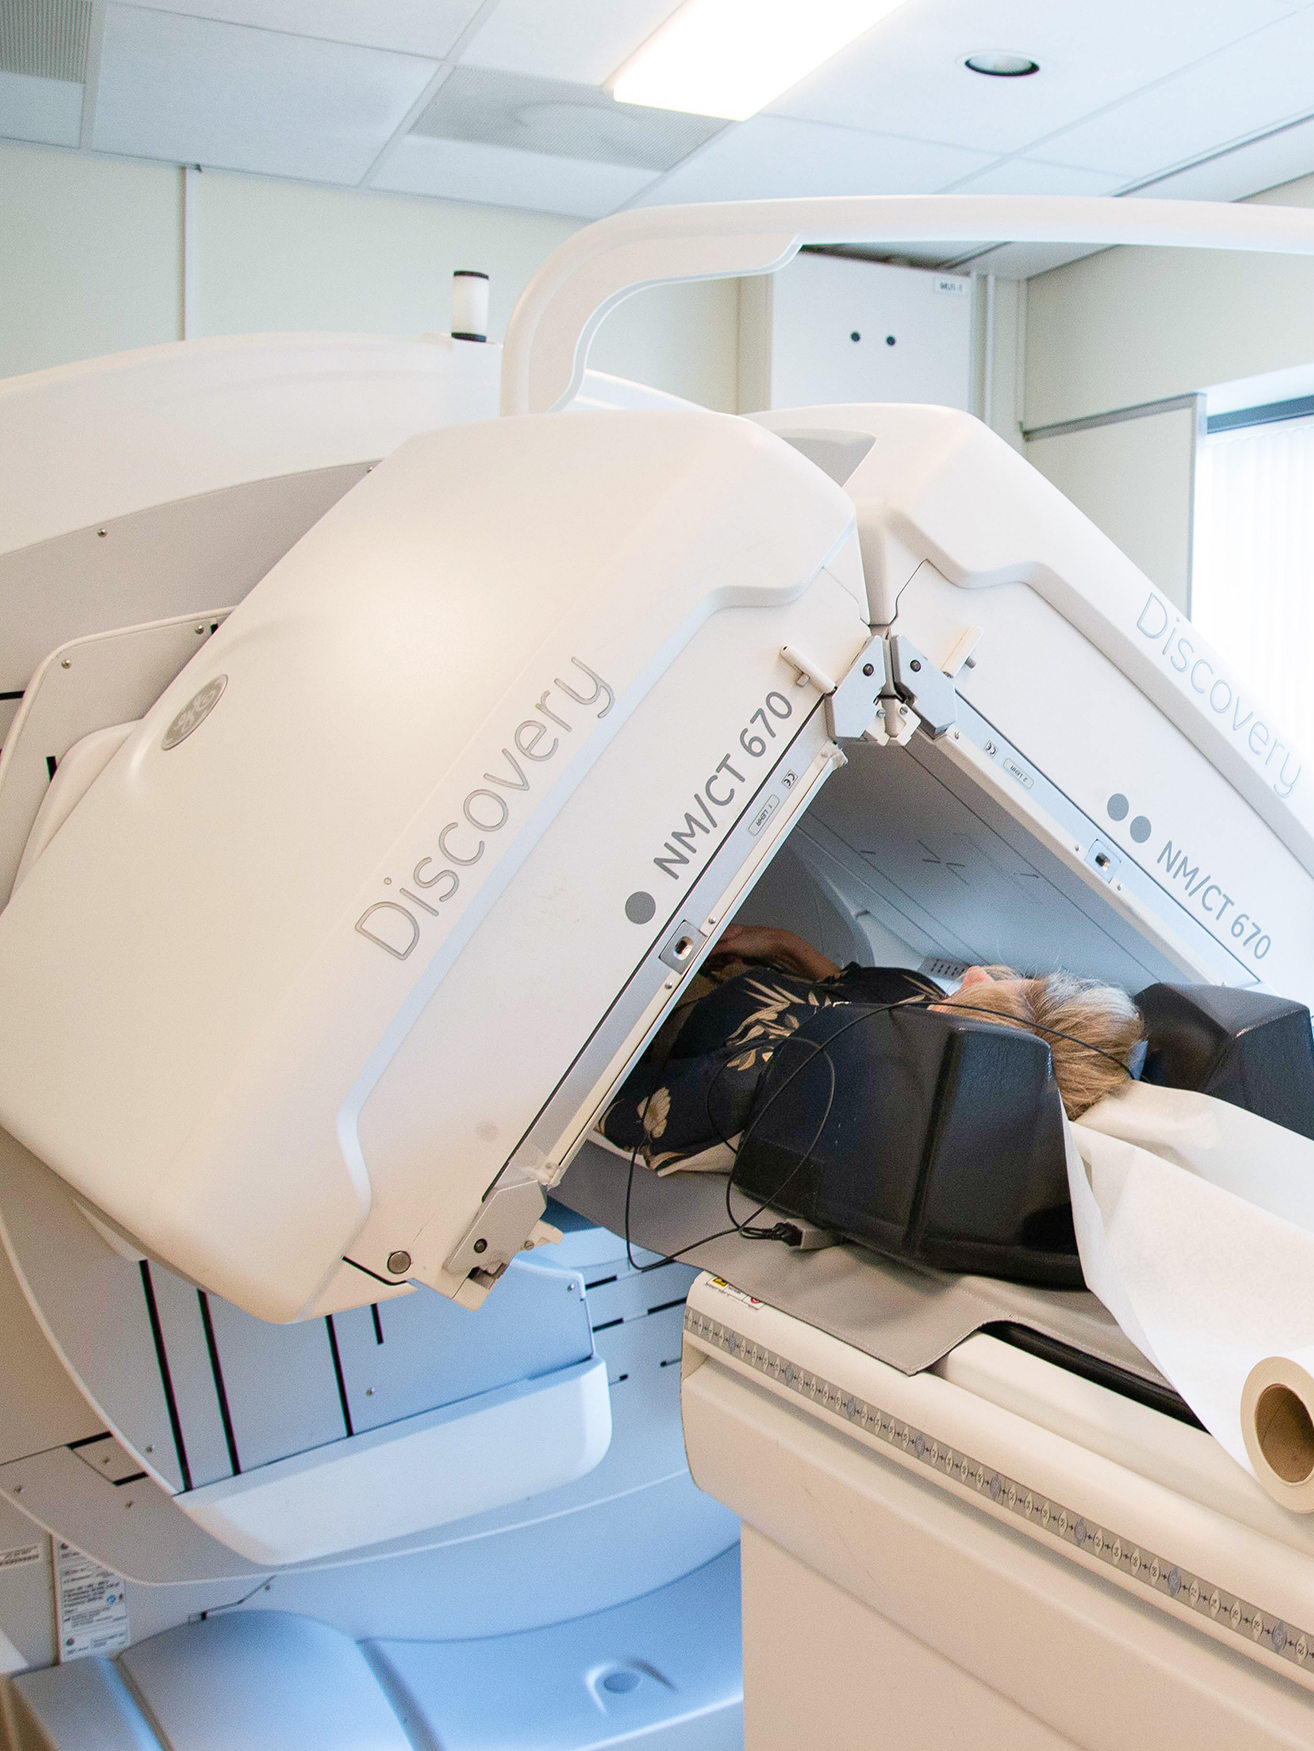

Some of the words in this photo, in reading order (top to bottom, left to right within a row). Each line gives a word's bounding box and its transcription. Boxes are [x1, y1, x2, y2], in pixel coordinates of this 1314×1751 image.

[653, 753, 746, 881] NM/CT
[739, 691, 793, 758] 670
[1136, 592, 1303, 799] Discovery
[355, 656, 616, 961] Discovery
[1156, 840, 1235, 921] NM/CT
[1231, 914, 1272, 960] 670
